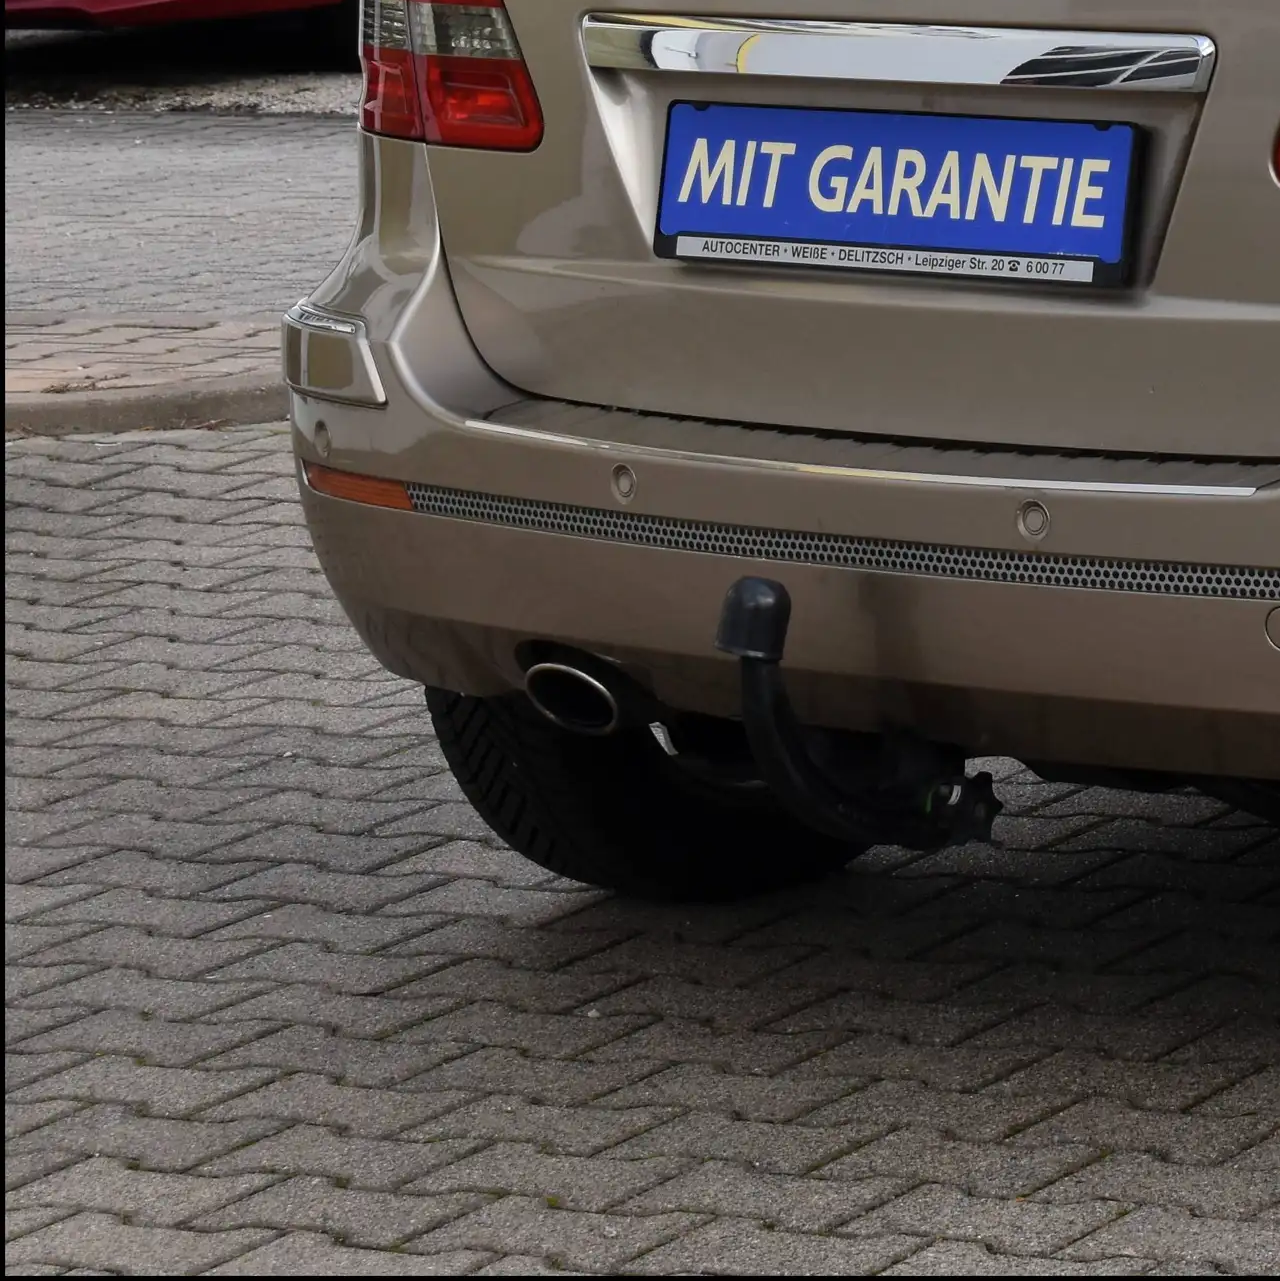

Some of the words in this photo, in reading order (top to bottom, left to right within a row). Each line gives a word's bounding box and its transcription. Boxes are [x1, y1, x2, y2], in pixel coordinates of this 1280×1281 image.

[677, 137, 796, 208] MIT
[808, 144, 1111, 228] GARANTIE
[702, 239, 780, 257] AUTOCENTER
[791, 246, 828, 260] WEIßE
[838, 248, 904, 265] DELITZSCH
[915, 253, 966, 271] Leipziger
[969, 257, 987, 270] Str.
[991, 259, 1004, 272] 20
